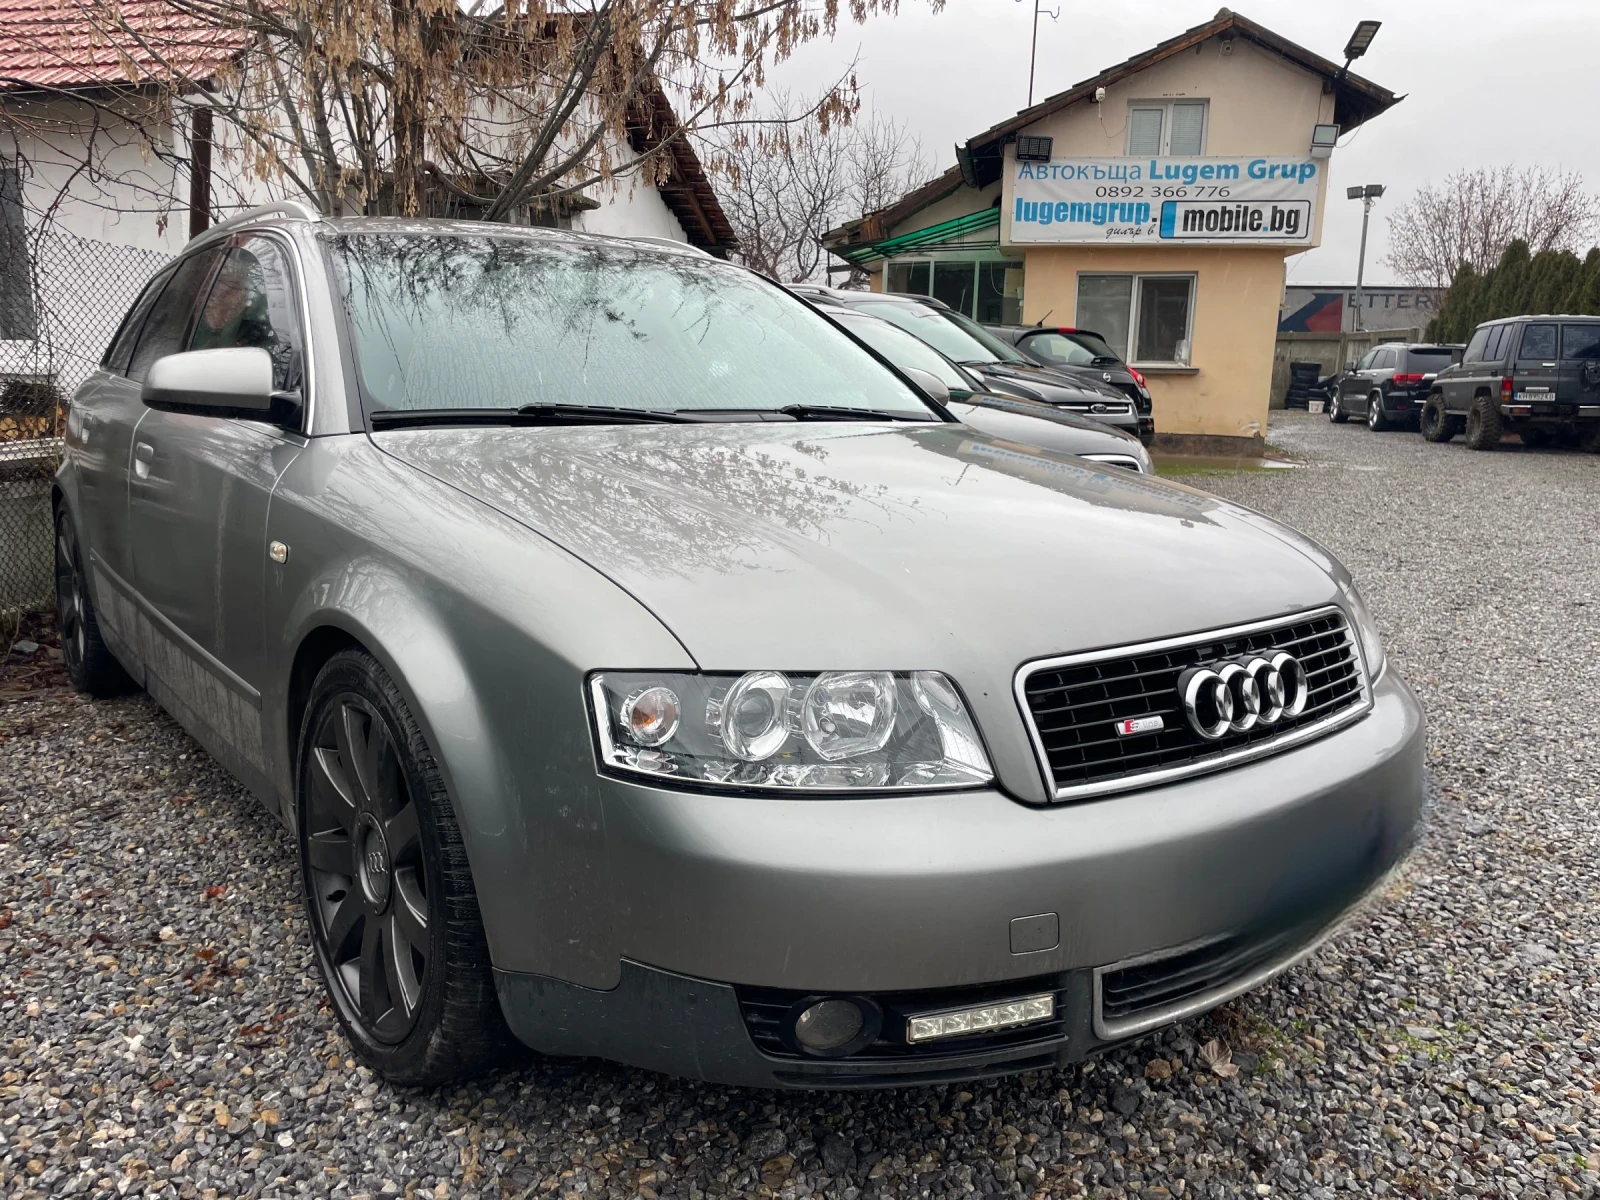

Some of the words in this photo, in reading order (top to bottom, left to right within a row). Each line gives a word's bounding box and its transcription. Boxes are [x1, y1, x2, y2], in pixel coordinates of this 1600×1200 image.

[1018, 161, 1141, 184] Автокъща
[1149, 159, 1239, 185] Lugem
[1247, 159, 1316, 184] Grup
[1095, 186, 1144, 198] 0892
[1150, 186, 1187, 198] 366
[1194, 186, 1230, 198] 776
[1182, 204, 1300, 235] mobile.bg
